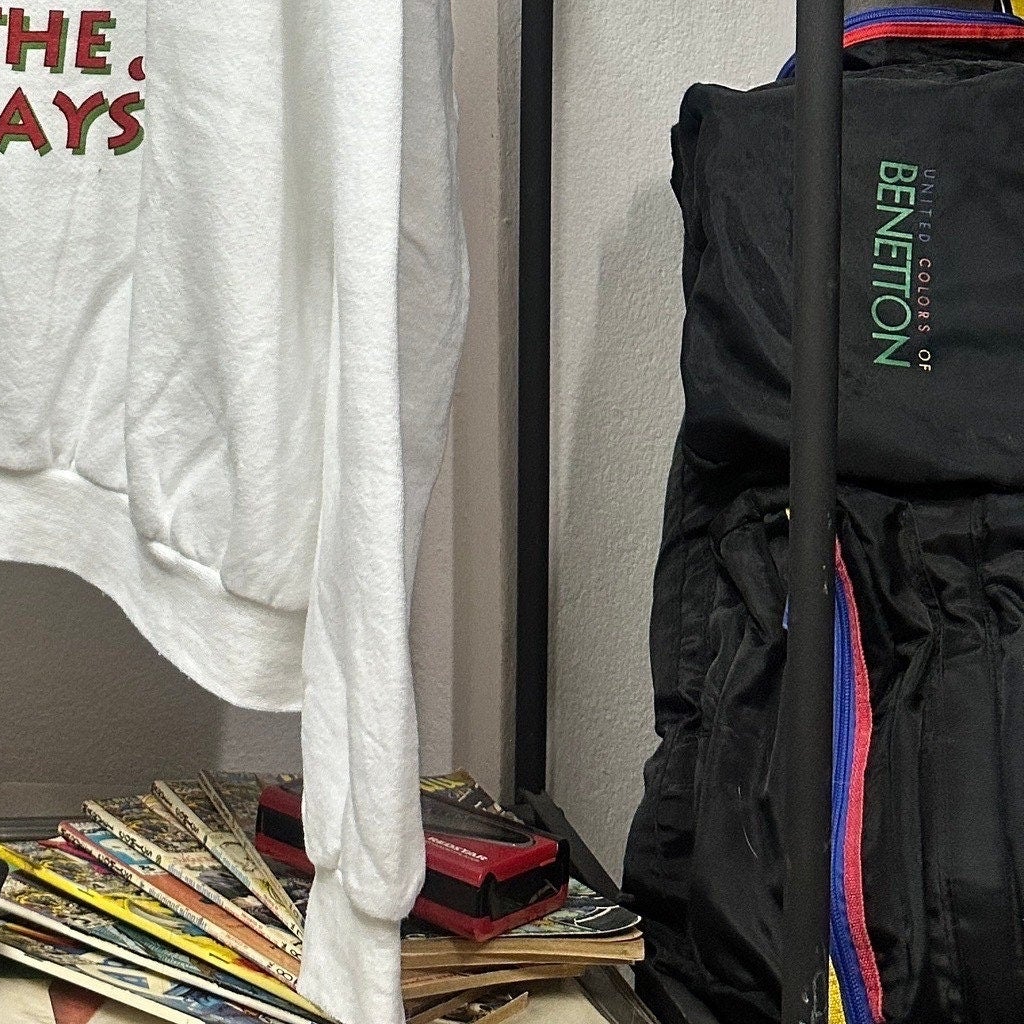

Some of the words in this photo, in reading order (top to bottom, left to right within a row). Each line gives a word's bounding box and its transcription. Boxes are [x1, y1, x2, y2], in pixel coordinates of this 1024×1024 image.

[918, 169, 936, 243] UNITED
[871, 160, 919, 368] BENETTON
[917, 258, 931, 332] COLORS
[918, 349, 932, 372] OF
